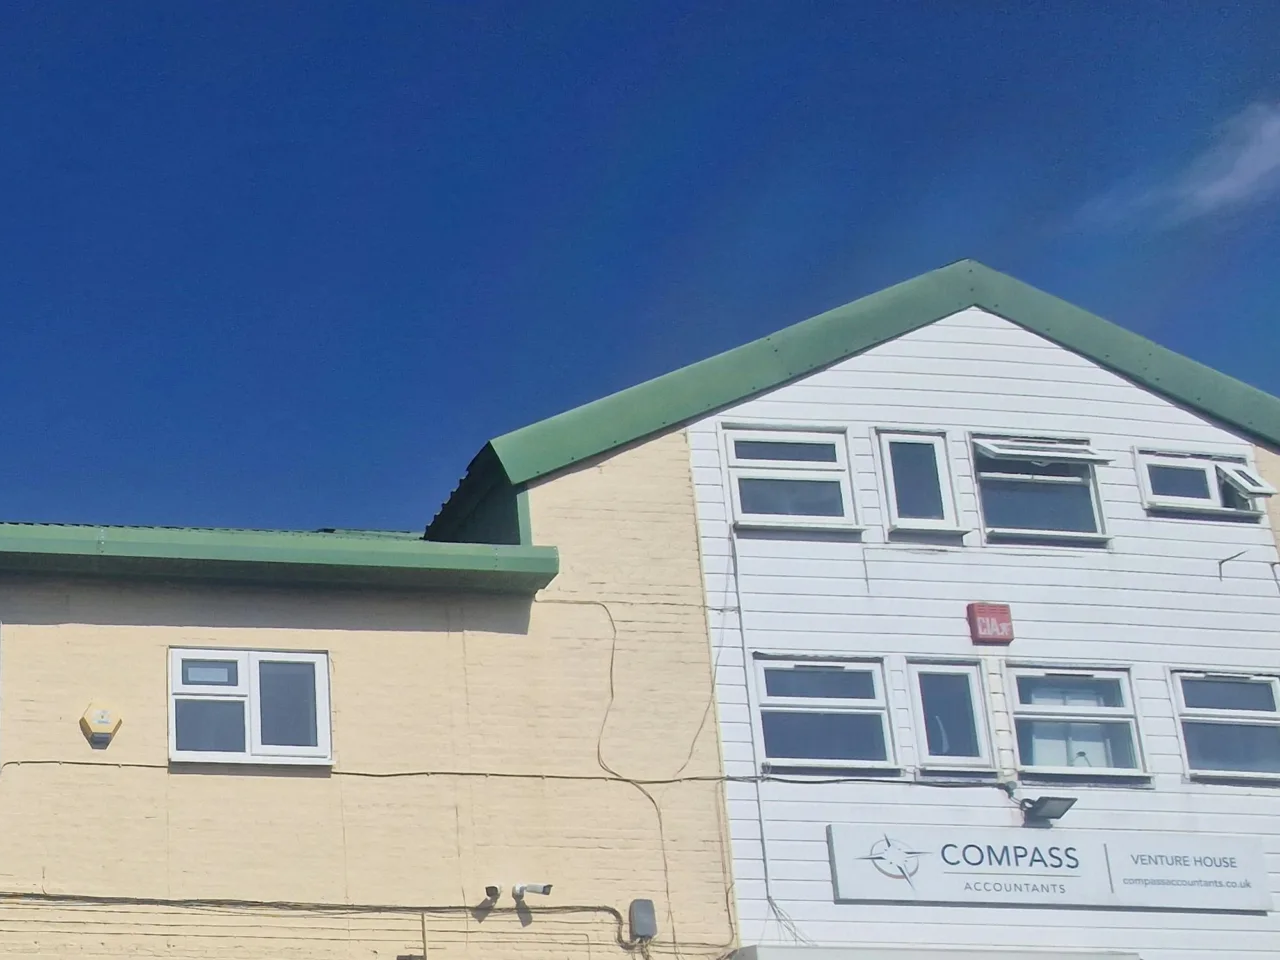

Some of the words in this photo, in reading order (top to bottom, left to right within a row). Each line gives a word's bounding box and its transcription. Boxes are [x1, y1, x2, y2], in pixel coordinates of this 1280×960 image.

[940, 843, 1080, 869] COMPASS
[1130, 854, 1191, 867] VENTURE
[1193, 856, 1238, 868] HOUSE
[963, 881, 1067, 894] ACCOUNTANTS
[1122, 877, 1252, 889] compassaccountants.co.uk
